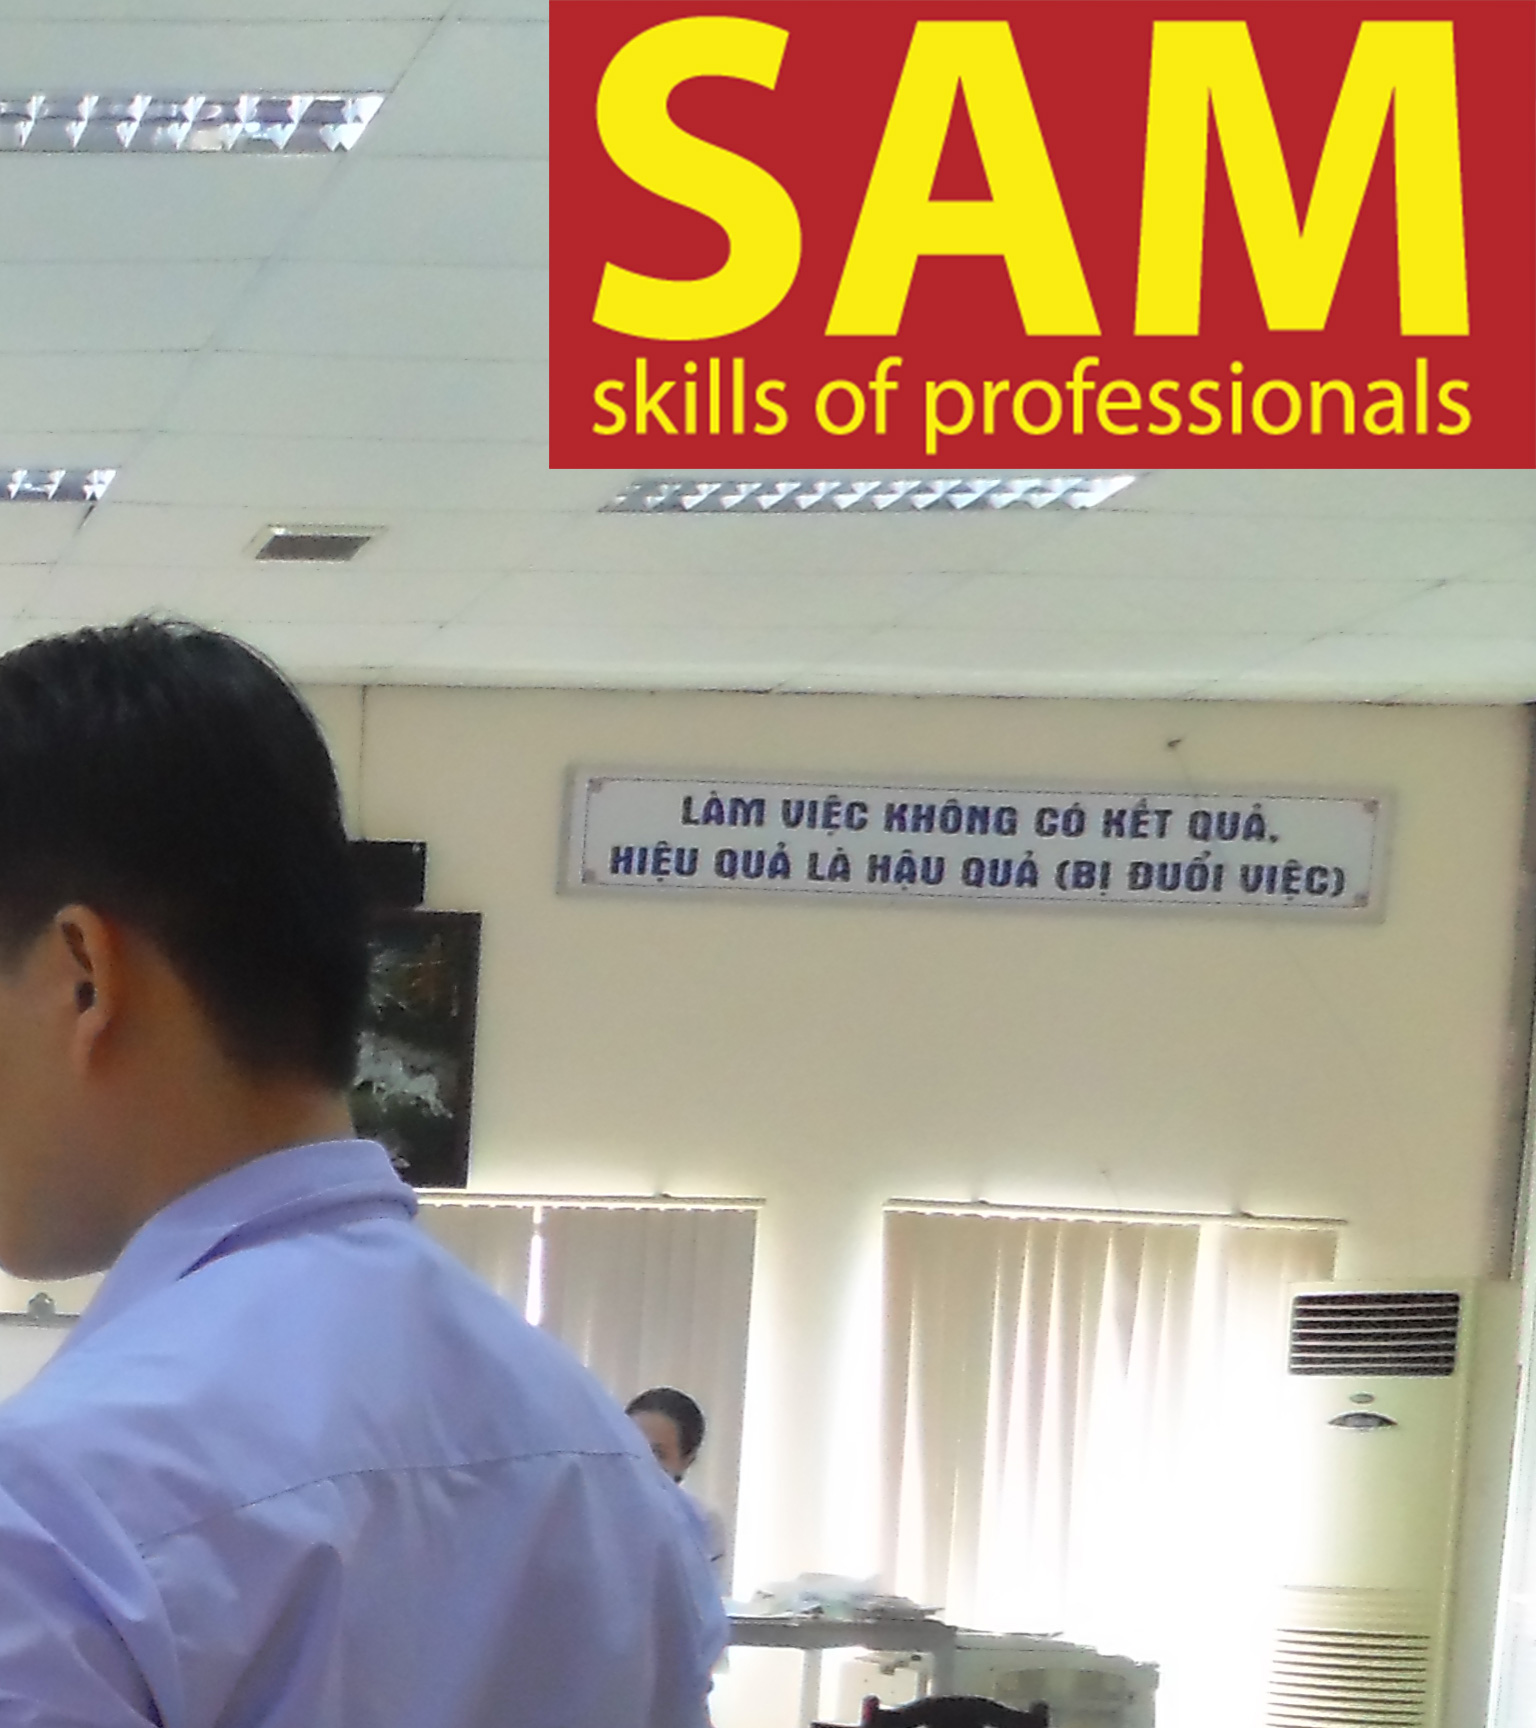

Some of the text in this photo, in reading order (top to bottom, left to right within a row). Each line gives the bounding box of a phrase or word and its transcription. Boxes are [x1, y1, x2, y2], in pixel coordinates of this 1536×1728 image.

[681, 790, 767, 828] LÀM
[780, 794, 870, 836] VIỆC
[882, 799, 1019, 837] KHÔNG
[1033, 801, 1086, 839] CÓ
[1101, 798, 1173, 841] KẾT
[609, 840, 699, 883] HIỆU
[713, 841, 791, 880] QUẢ
[806, 847, 851, 883] LÀ
[866, 849, 945, 892] HẬU
[960, 849, 1039, 890] QUẢ
[1053, 858, 1112, 896] (BỊ
[1239, 859, 1346, 901] VIỆC)
